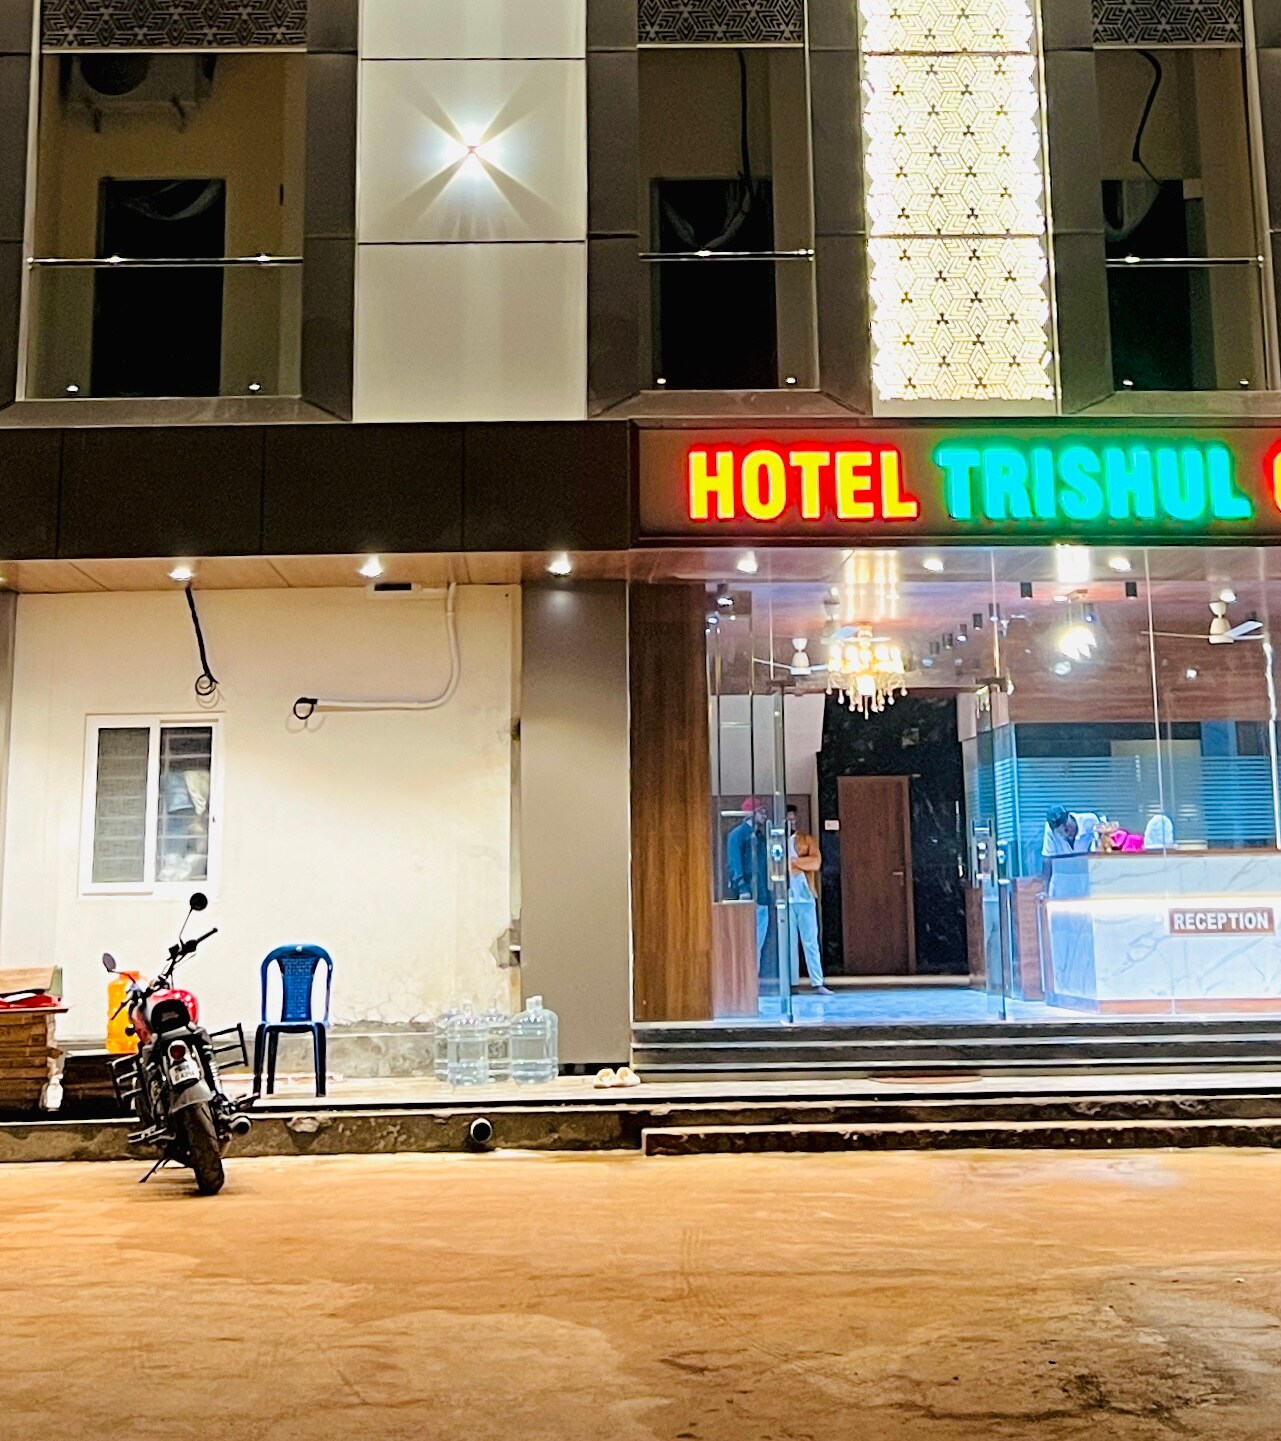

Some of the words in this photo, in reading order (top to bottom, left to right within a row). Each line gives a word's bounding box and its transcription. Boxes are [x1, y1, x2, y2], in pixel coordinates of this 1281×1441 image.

[688, 449, 918, 520] HOTEL
[936, 446, 1251, 519] TRISHUL
[1173, 912, 1269, 930] RECEPTION
